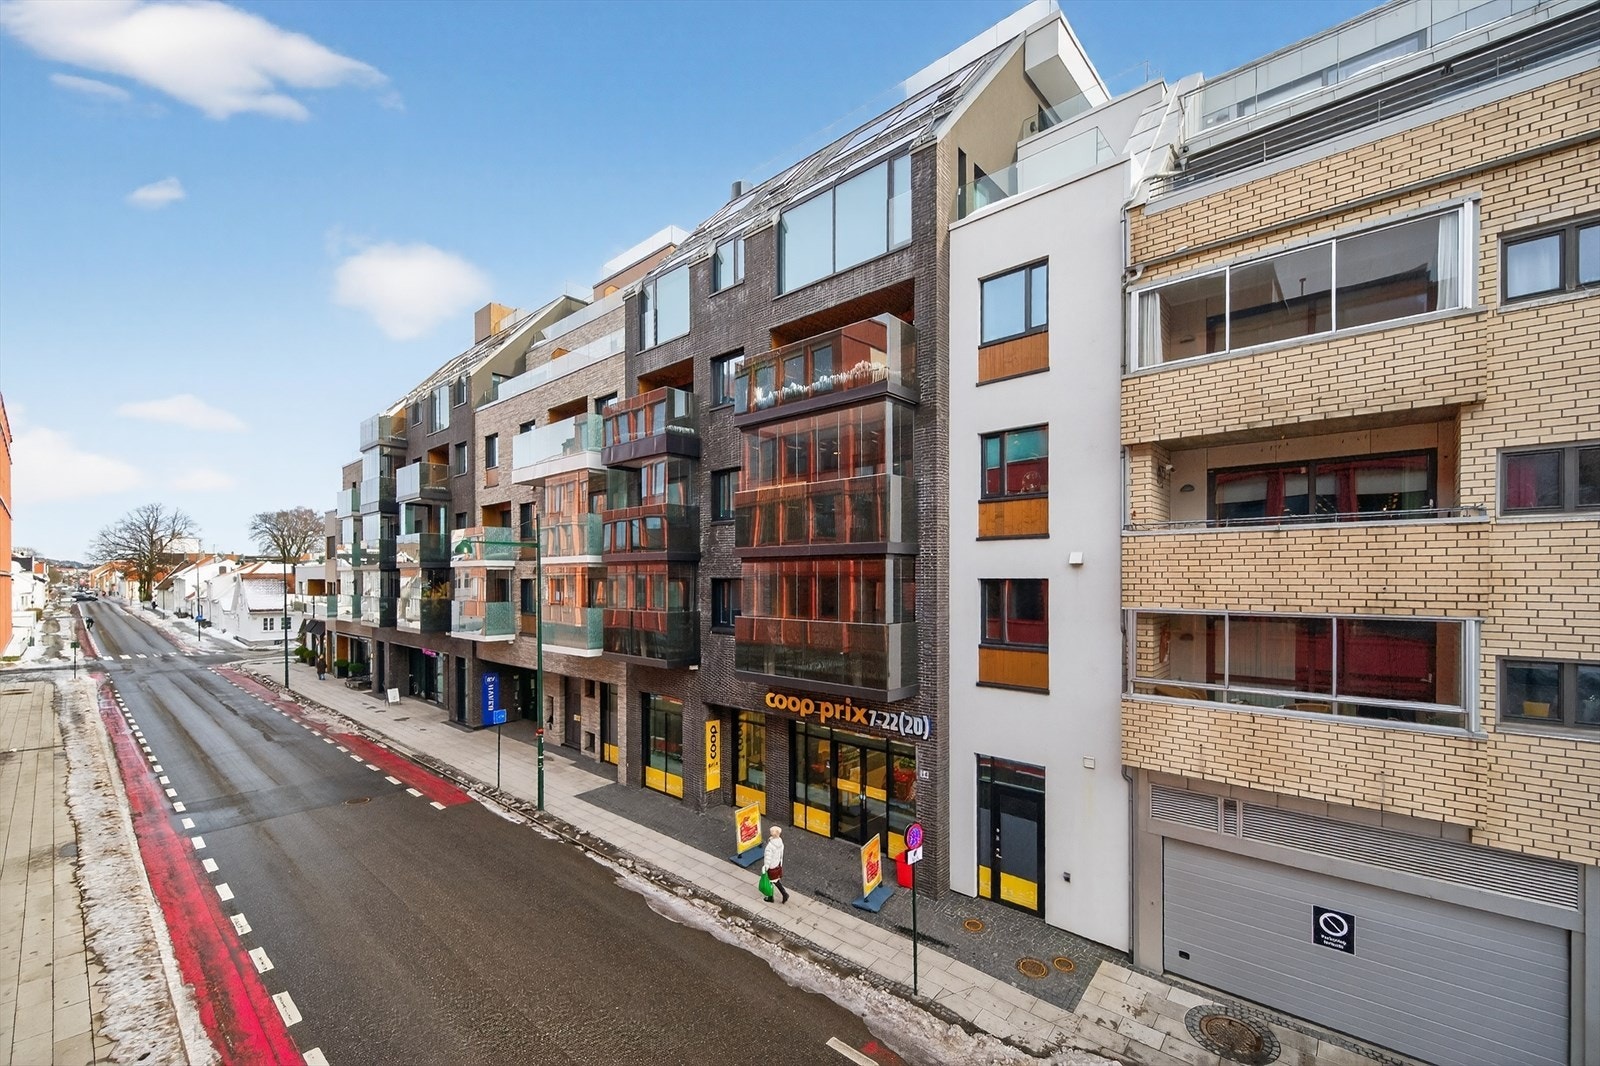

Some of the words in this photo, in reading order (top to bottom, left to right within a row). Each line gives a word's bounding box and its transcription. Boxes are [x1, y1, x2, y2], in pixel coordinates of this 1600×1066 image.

[765, 692, 815, 717] coop
[820, 697, 869, 724] prix
[868, 709, 931, 740] 7-22(20)
[710, 725, 718, 759] coop
